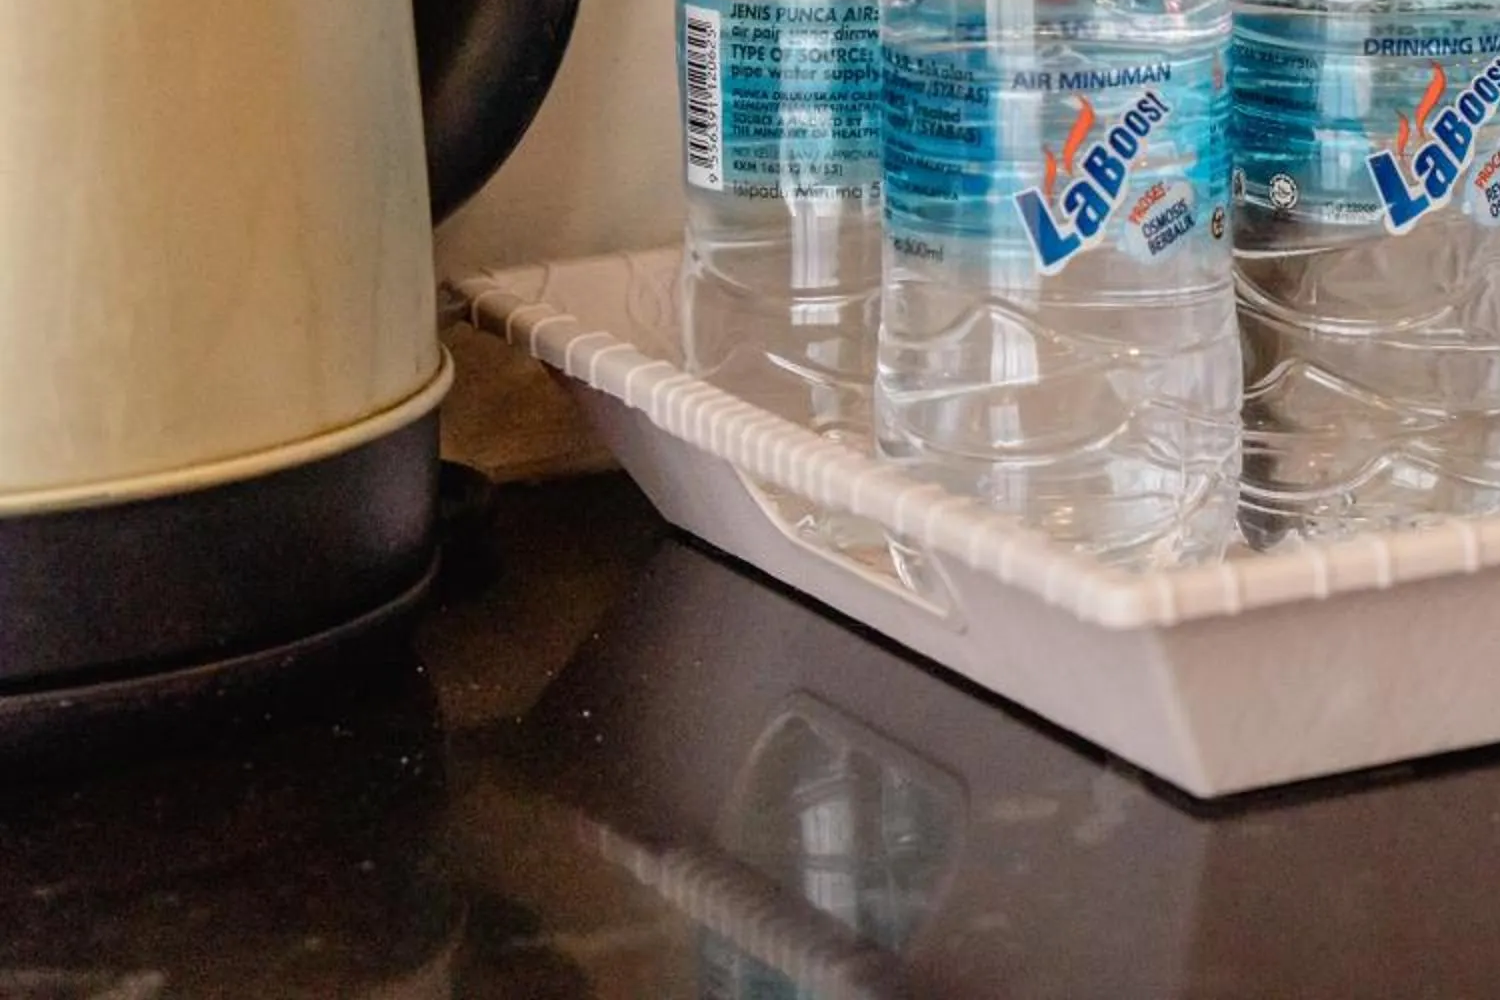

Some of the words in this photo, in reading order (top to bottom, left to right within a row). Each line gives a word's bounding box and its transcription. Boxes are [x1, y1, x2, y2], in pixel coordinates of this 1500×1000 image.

[730, 3, 771, 21] JENIS
[776, 7, 837, 23] PUNCA
[843, 5, 880, 21] AIR:
[731, 21, 749, 37] air
[731, 43, 765, 61] TYPE
[770, 47, 792, 62] OF
[798, 47, 874, 63] SOURCE:
[1363, 37, 1473, 56] DRINKING
[823, 63, 881, 84] supply
[1012, 72, 1051, 89] AIR
[1059, 64, 1171, 89] MINUMAN
